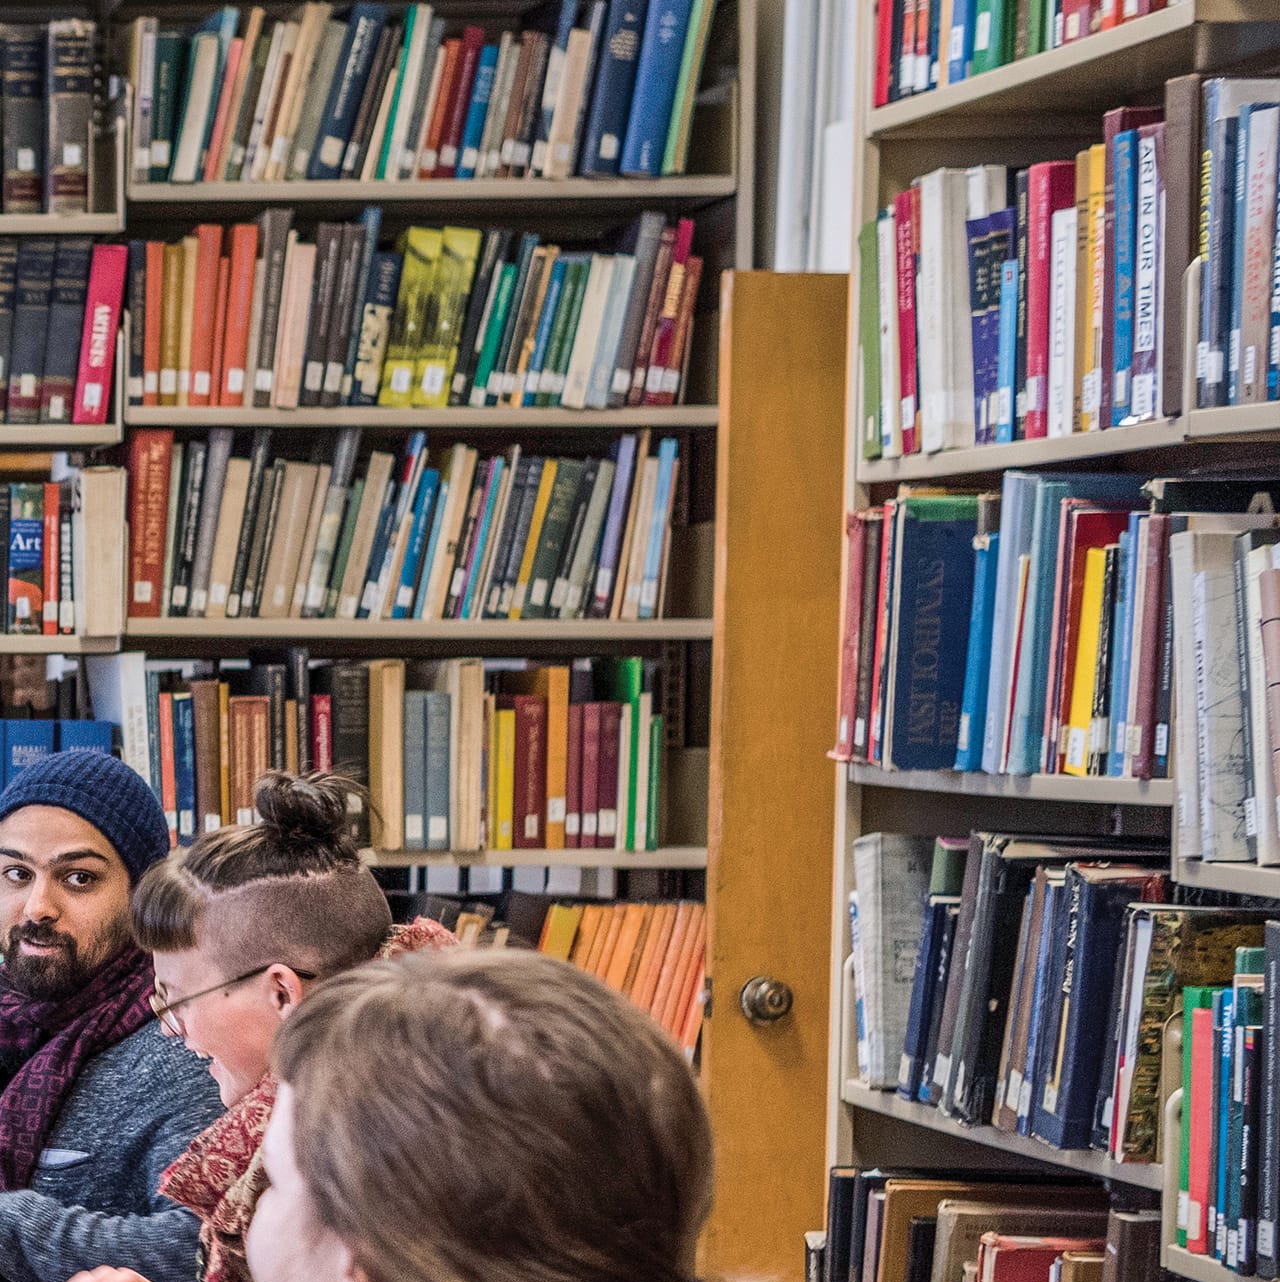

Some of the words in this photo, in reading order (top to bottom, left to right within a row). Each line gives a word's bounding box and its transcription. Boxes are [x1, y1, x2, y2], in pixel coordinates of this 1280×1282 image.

[1139, 144, 1155, 187] ART
[1200, 149, 1213, 206] CHUCK
[1117, 140, 1132, 262] Modern
[1139, 196, 1154, 218] IN
[1139, 223, 1154, 271] OUR
[1199, 209, 1211, 262] CLOSE
[1117, 272, 1132, 320] Art
[1139, 283, 1154, 348] TIMES
[10, 533, 43, 551] Art
[1066, 918, 1078, 949] New
[1221, 1002, 1234, 1058] Traffic:
